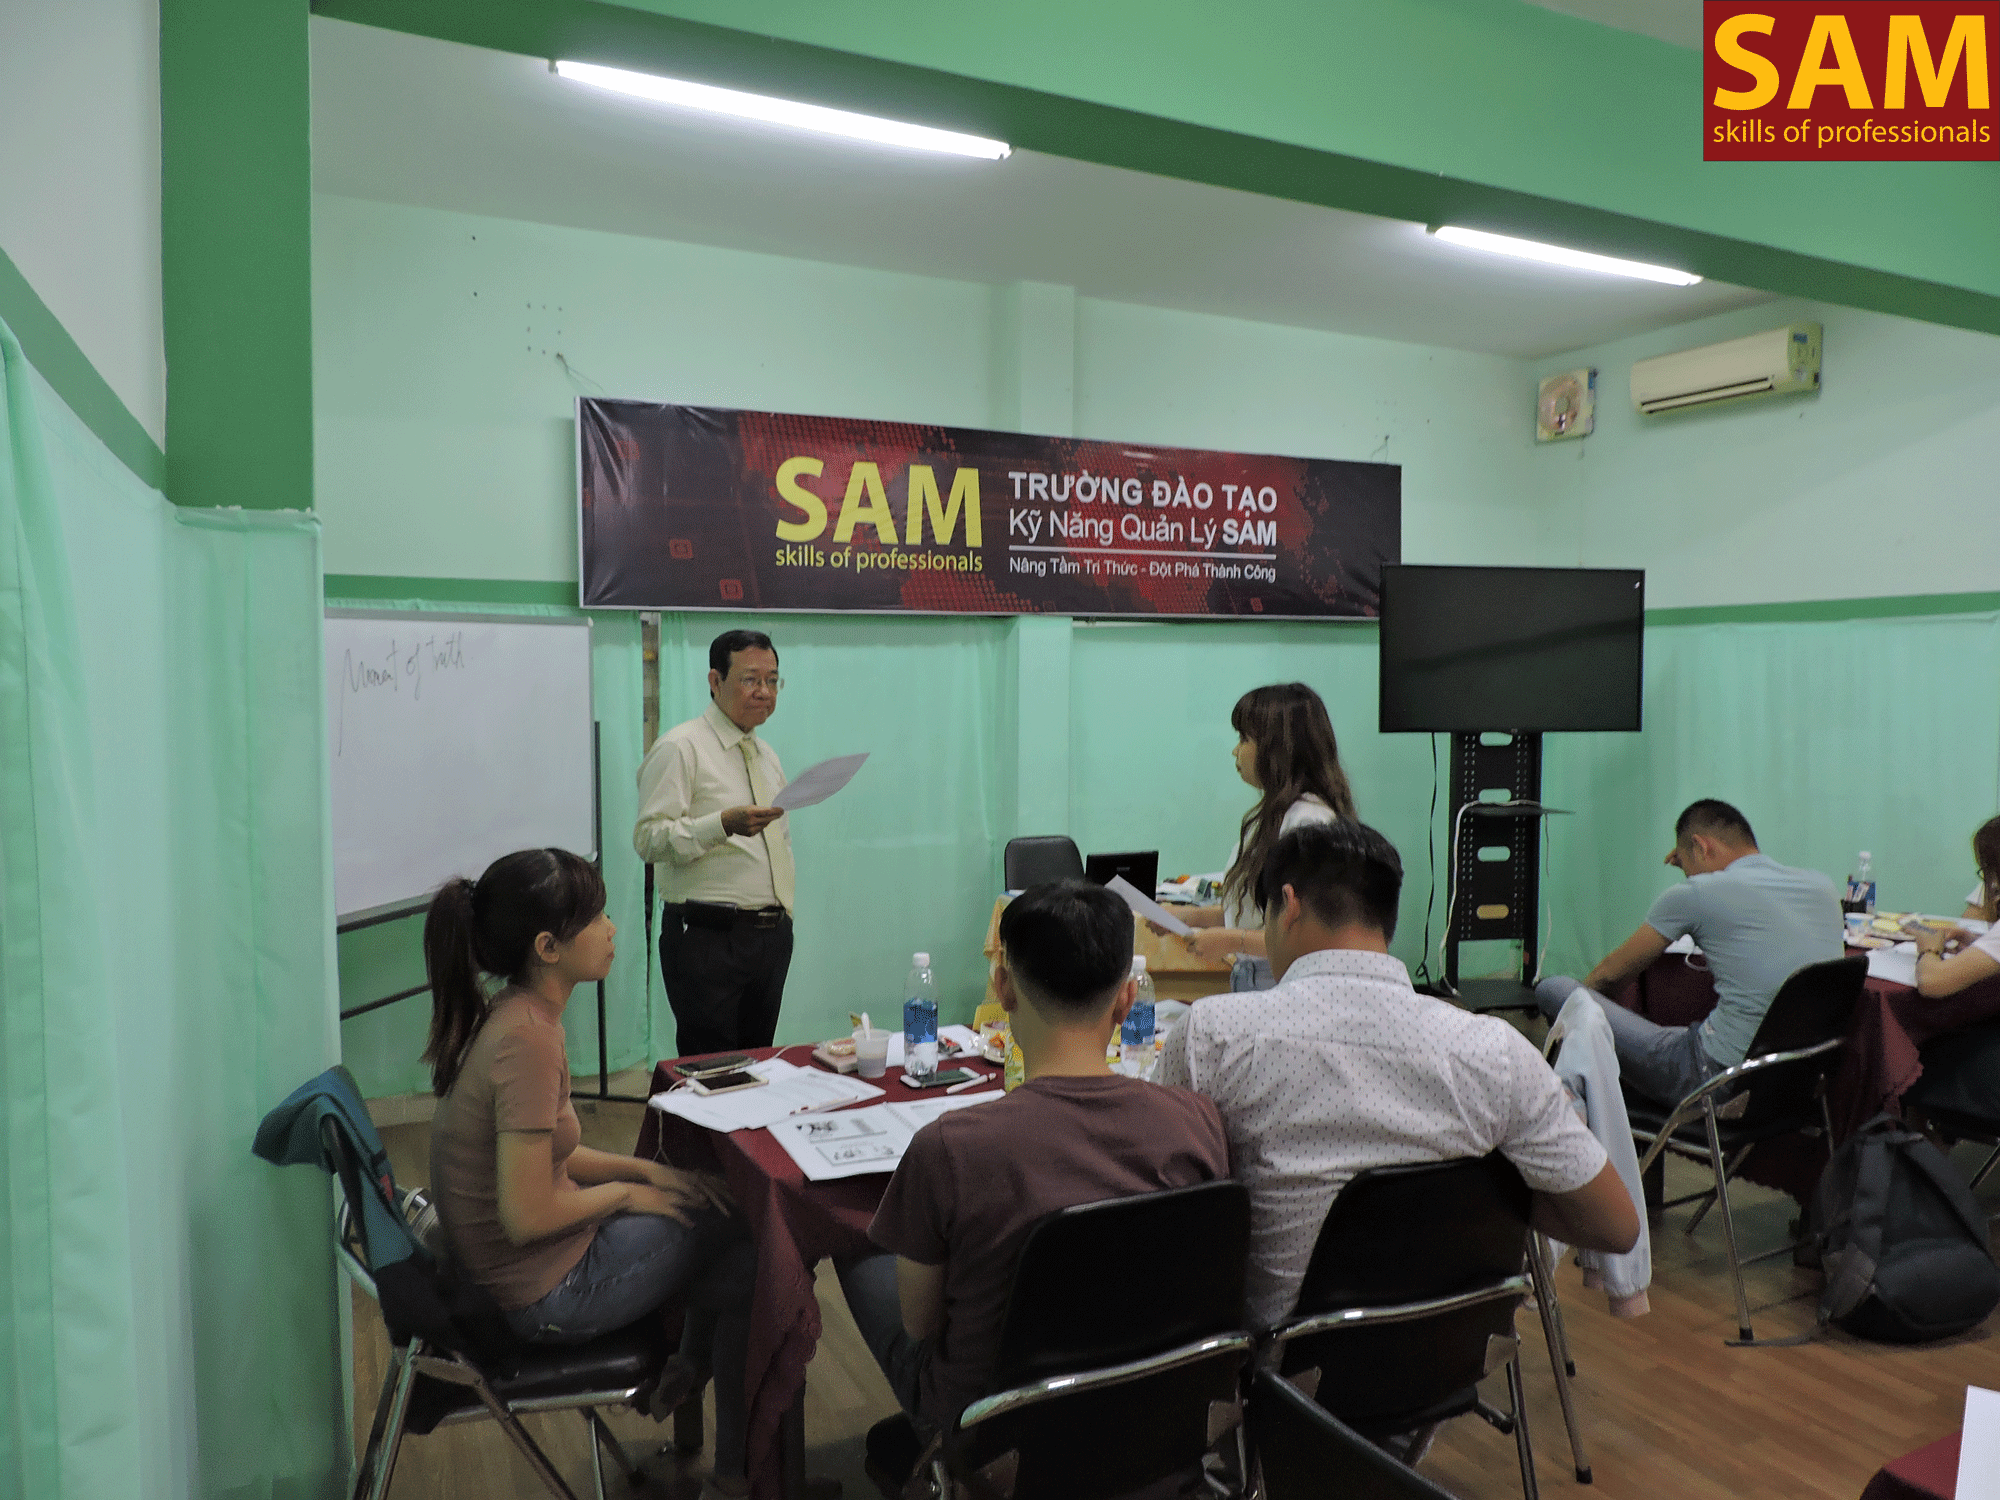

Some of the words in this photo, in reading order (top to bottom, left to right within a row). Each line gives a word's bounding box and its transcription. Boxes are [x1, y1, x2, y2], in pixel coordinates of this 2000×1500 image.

[775, 456, 983, 548] SAM
[1008, 469, 1143, 506] TRƯỜNG
[1151, 475, 1213, 510] ĐÀO
[1222, 484, 1278, 518] TẠO
[1009, 508, 1043, 544] Kỹ
[1050, 510, 1114, 546] Năng
[1120, 513, 1184, 543] Quản
[1191, 517, 1218, 550] Lý
[1222, 517, 1277, 547] SAM
[775, 543, 825, 568] skills
[830, 546, 852, 569] of
[856, 547, 983, 574] professionals
